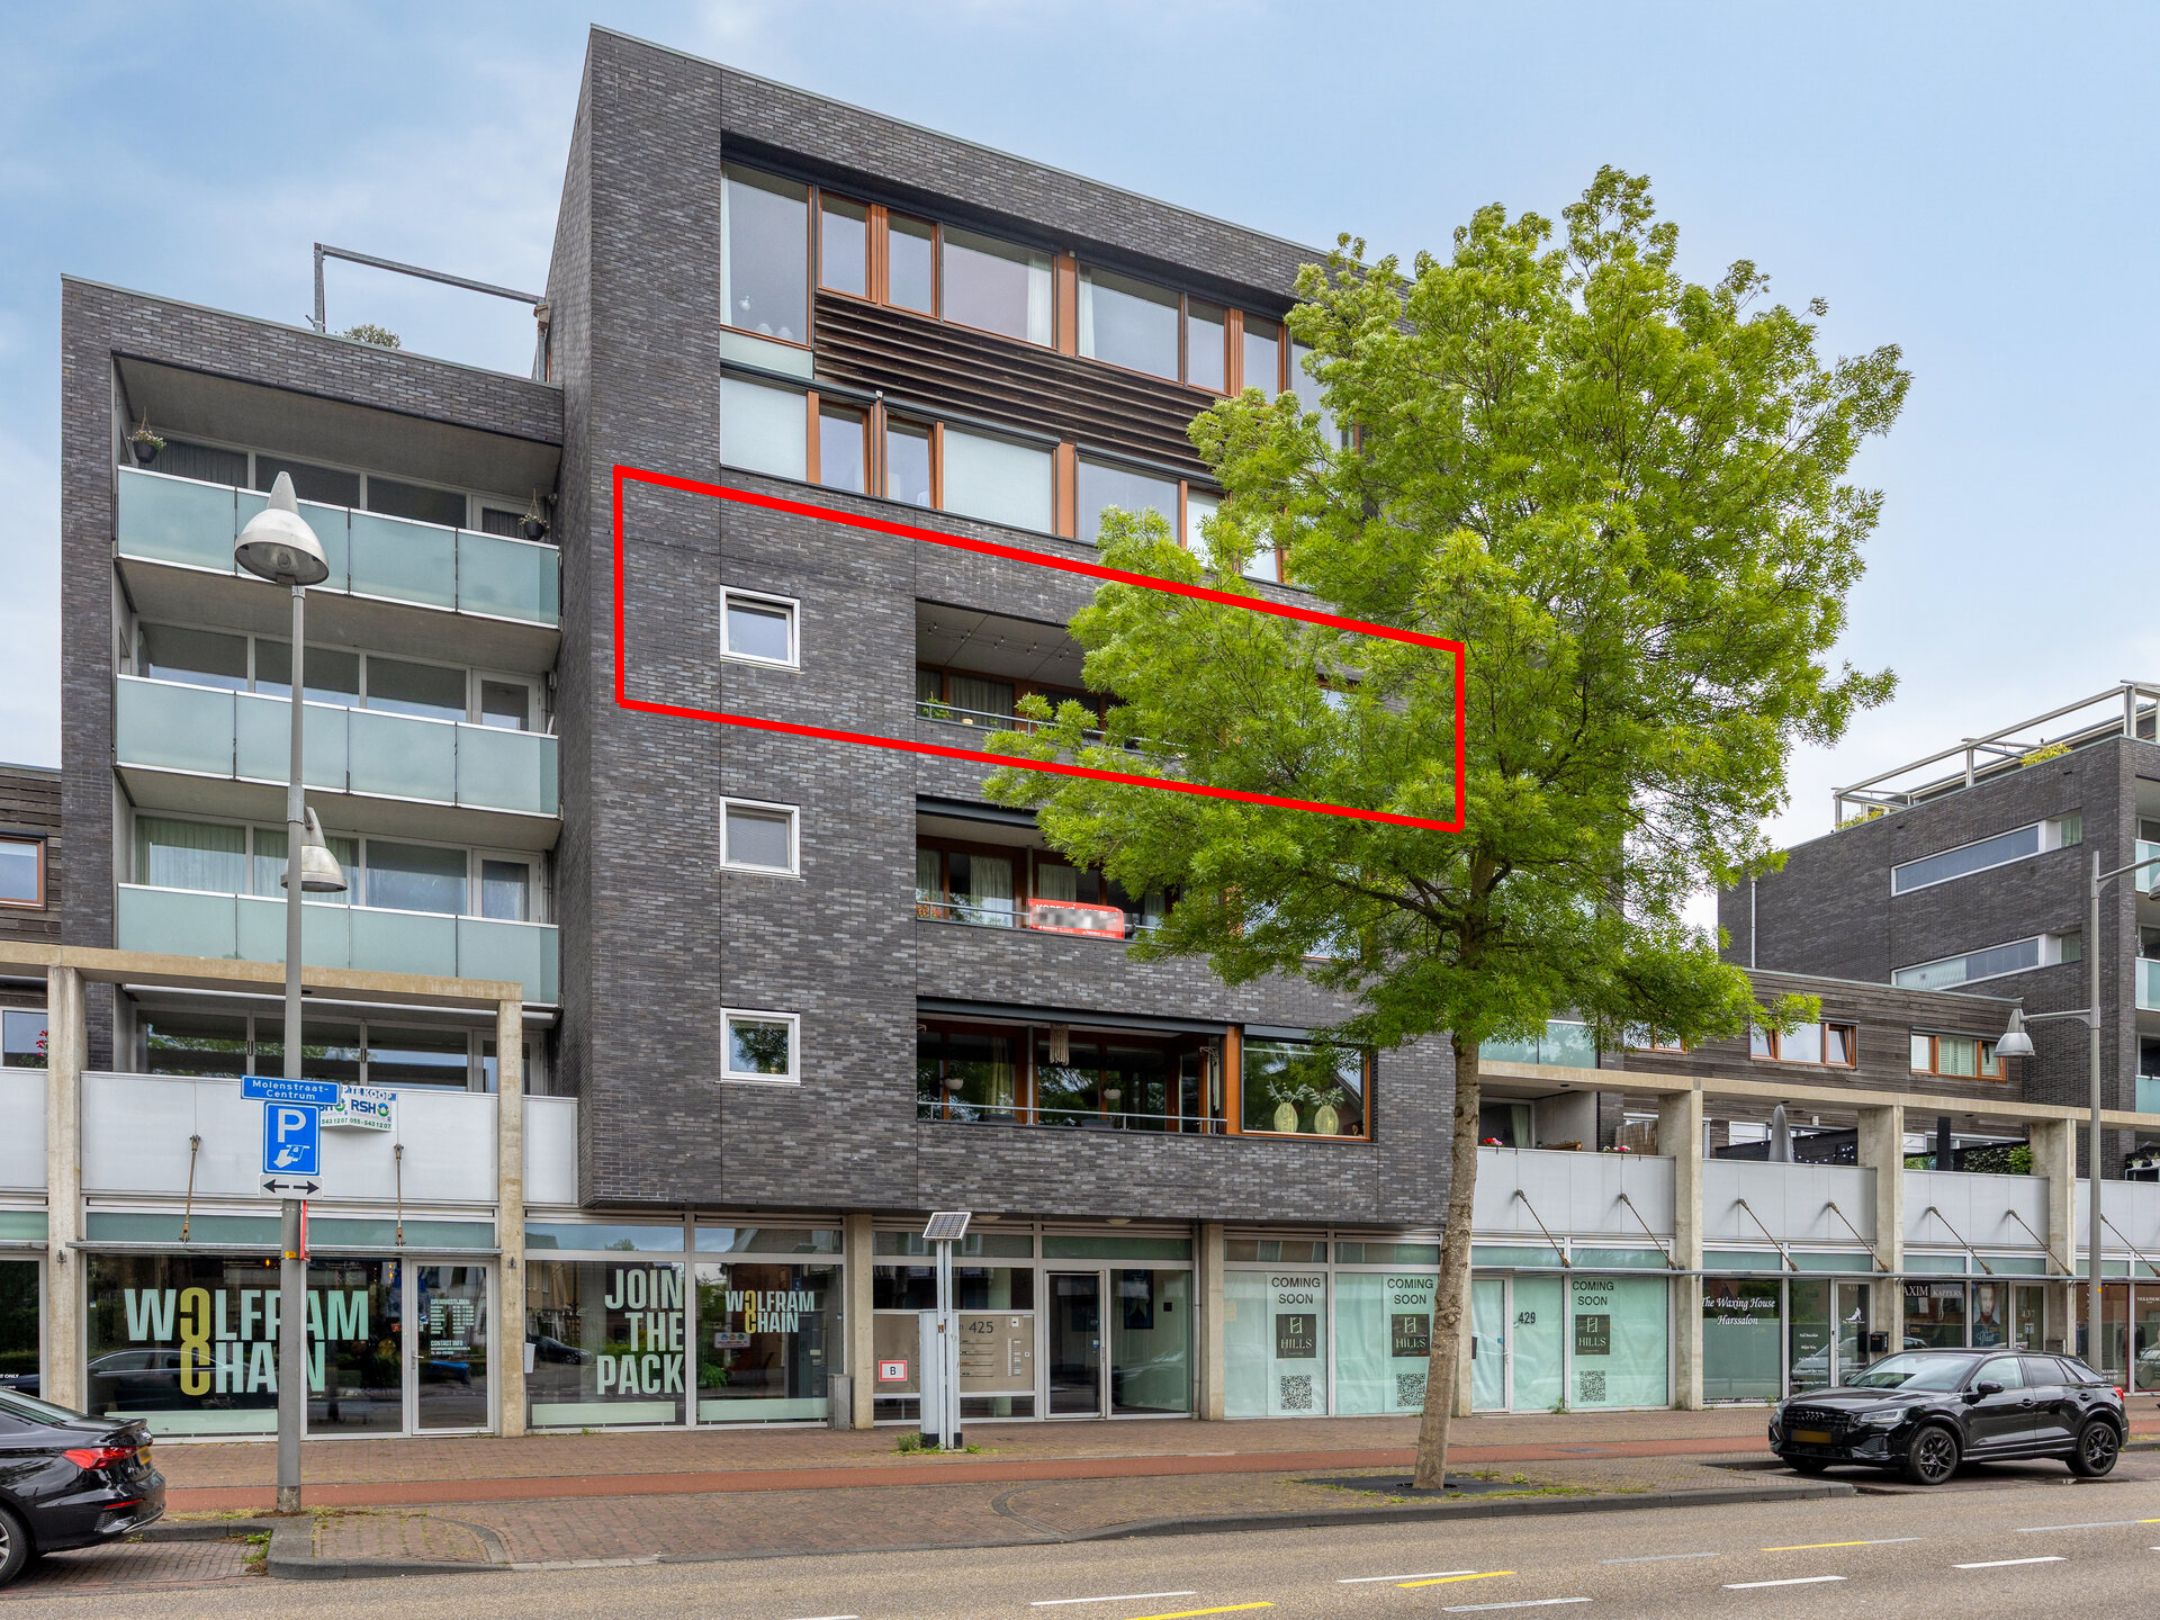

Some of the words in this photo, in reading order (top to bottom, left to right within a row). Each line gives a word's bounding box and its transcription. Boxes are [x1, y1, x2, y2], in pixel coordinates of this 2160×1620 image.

[252, 1079, 329, 1092] Molenstraat-
[266, 1089, 316, 1101] Centrum
[351, 1099, 376, 1114] RSH
[277, 1108, 307, 1143] P
[1271, 1277, 1321, 1288] COMING
[1387, 1278, 1434, 1289] COMING
[1572, 1280, 1614, 1291] COMING
[604, 1269, 684, 1310] JOIN
[1904, 1285, 1929, 1297] AXIM
[725, 1290, 815, 1313] WOLFRAM
[1278, 1294, 1314, 1304] SOON
[1394, 1294, 1427, 1305] SOON
[1577, 1295, 1608, 1306] SOON
[1702, 1296, 1715, 1308] The
[1716, 1296, 1748, 1311] Waxing
[1749, 1297, 1776, 1308] House
[744, 1311, 799, 1334] CHAIN
[1518, 1312, 1536, 1324] 429
[1717, 1314, 1759, 1326] Harssalon
[625, 1312, 684, 1352] THE
[968, 1321, 994, 1334] 425
[1280, 1338, 1313, 1350] HILLS
[1395, 1337, 1426, 1349] HILLS
[1578, 1336, 1607, 1347] HILLS
[180, 1340, 326, 1396] CHAN
[596, 1353, 685, 1395] PACK
[890, 1366, 897, 1376] B
